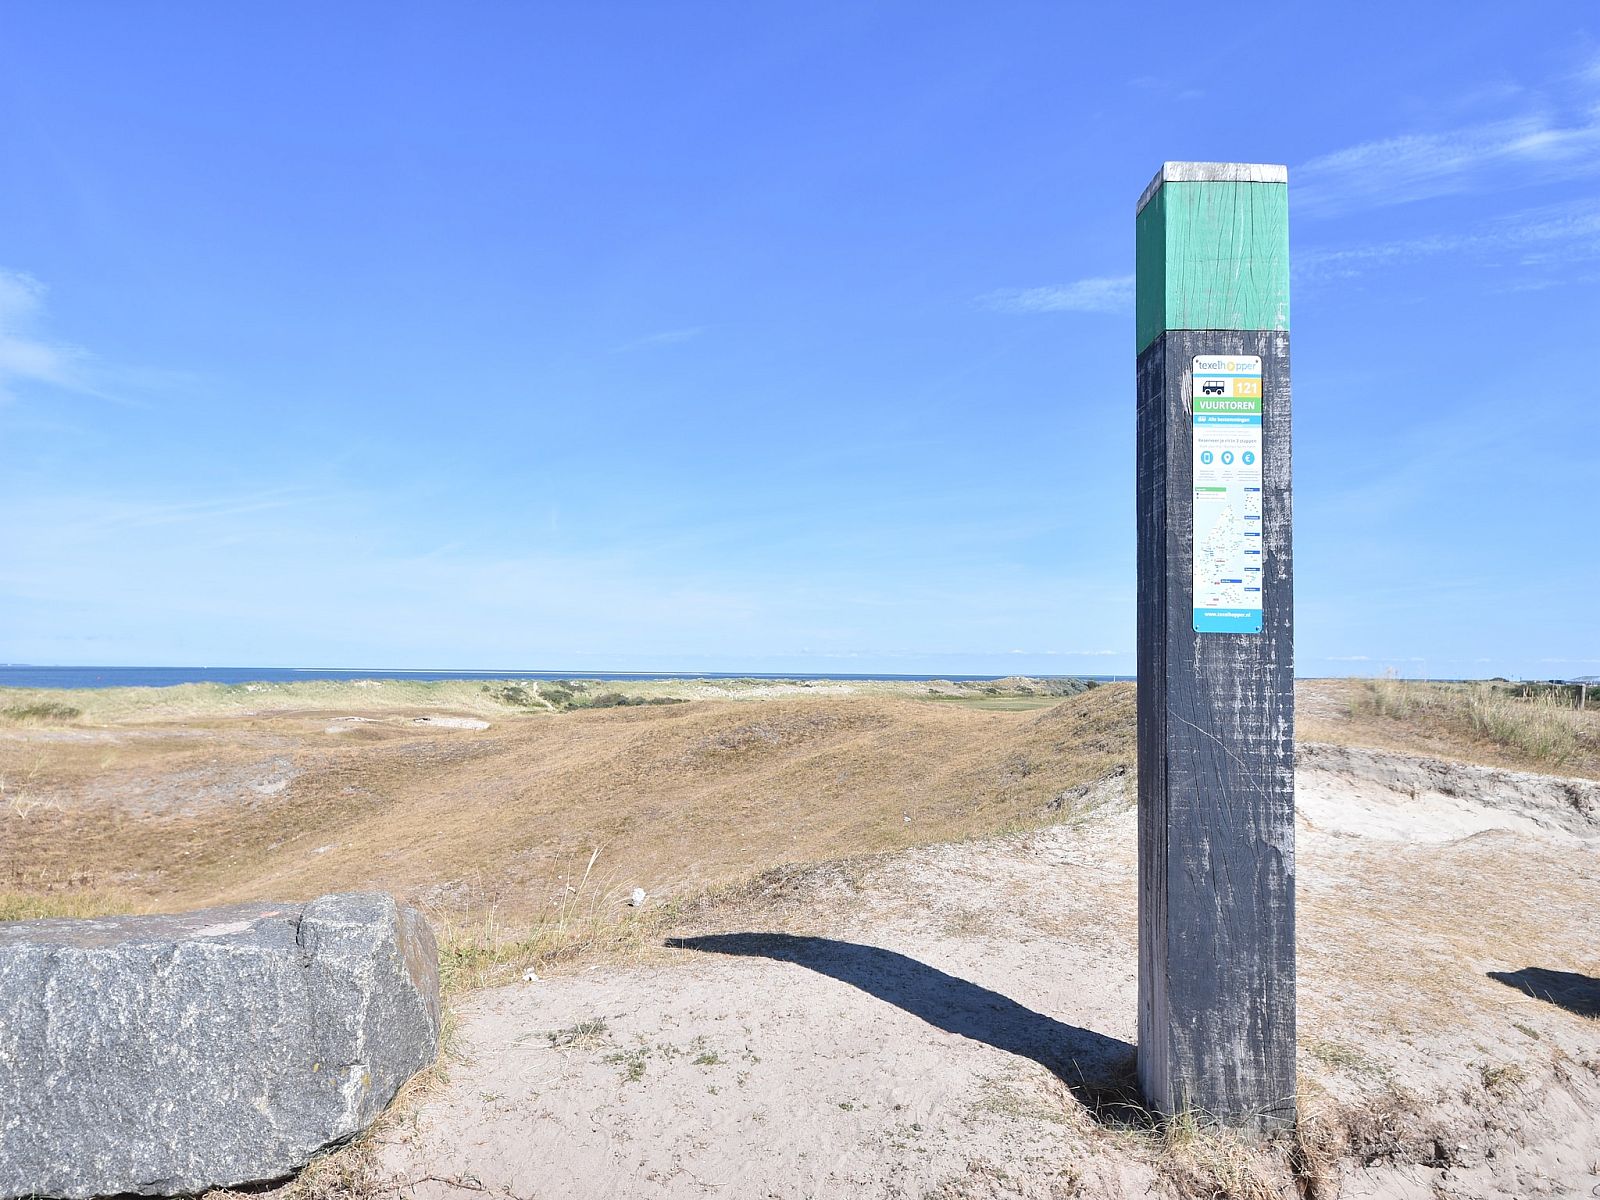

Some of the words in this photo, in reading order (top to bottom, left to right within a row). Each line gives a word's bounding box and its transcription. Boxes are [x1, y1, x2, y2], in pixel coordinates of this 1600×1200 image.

[1199, 361, 1256, 371] texelhopper
[1237, 382, 1257, 394] 121
[1199, 401, 1255, 410] VUURTOREN
